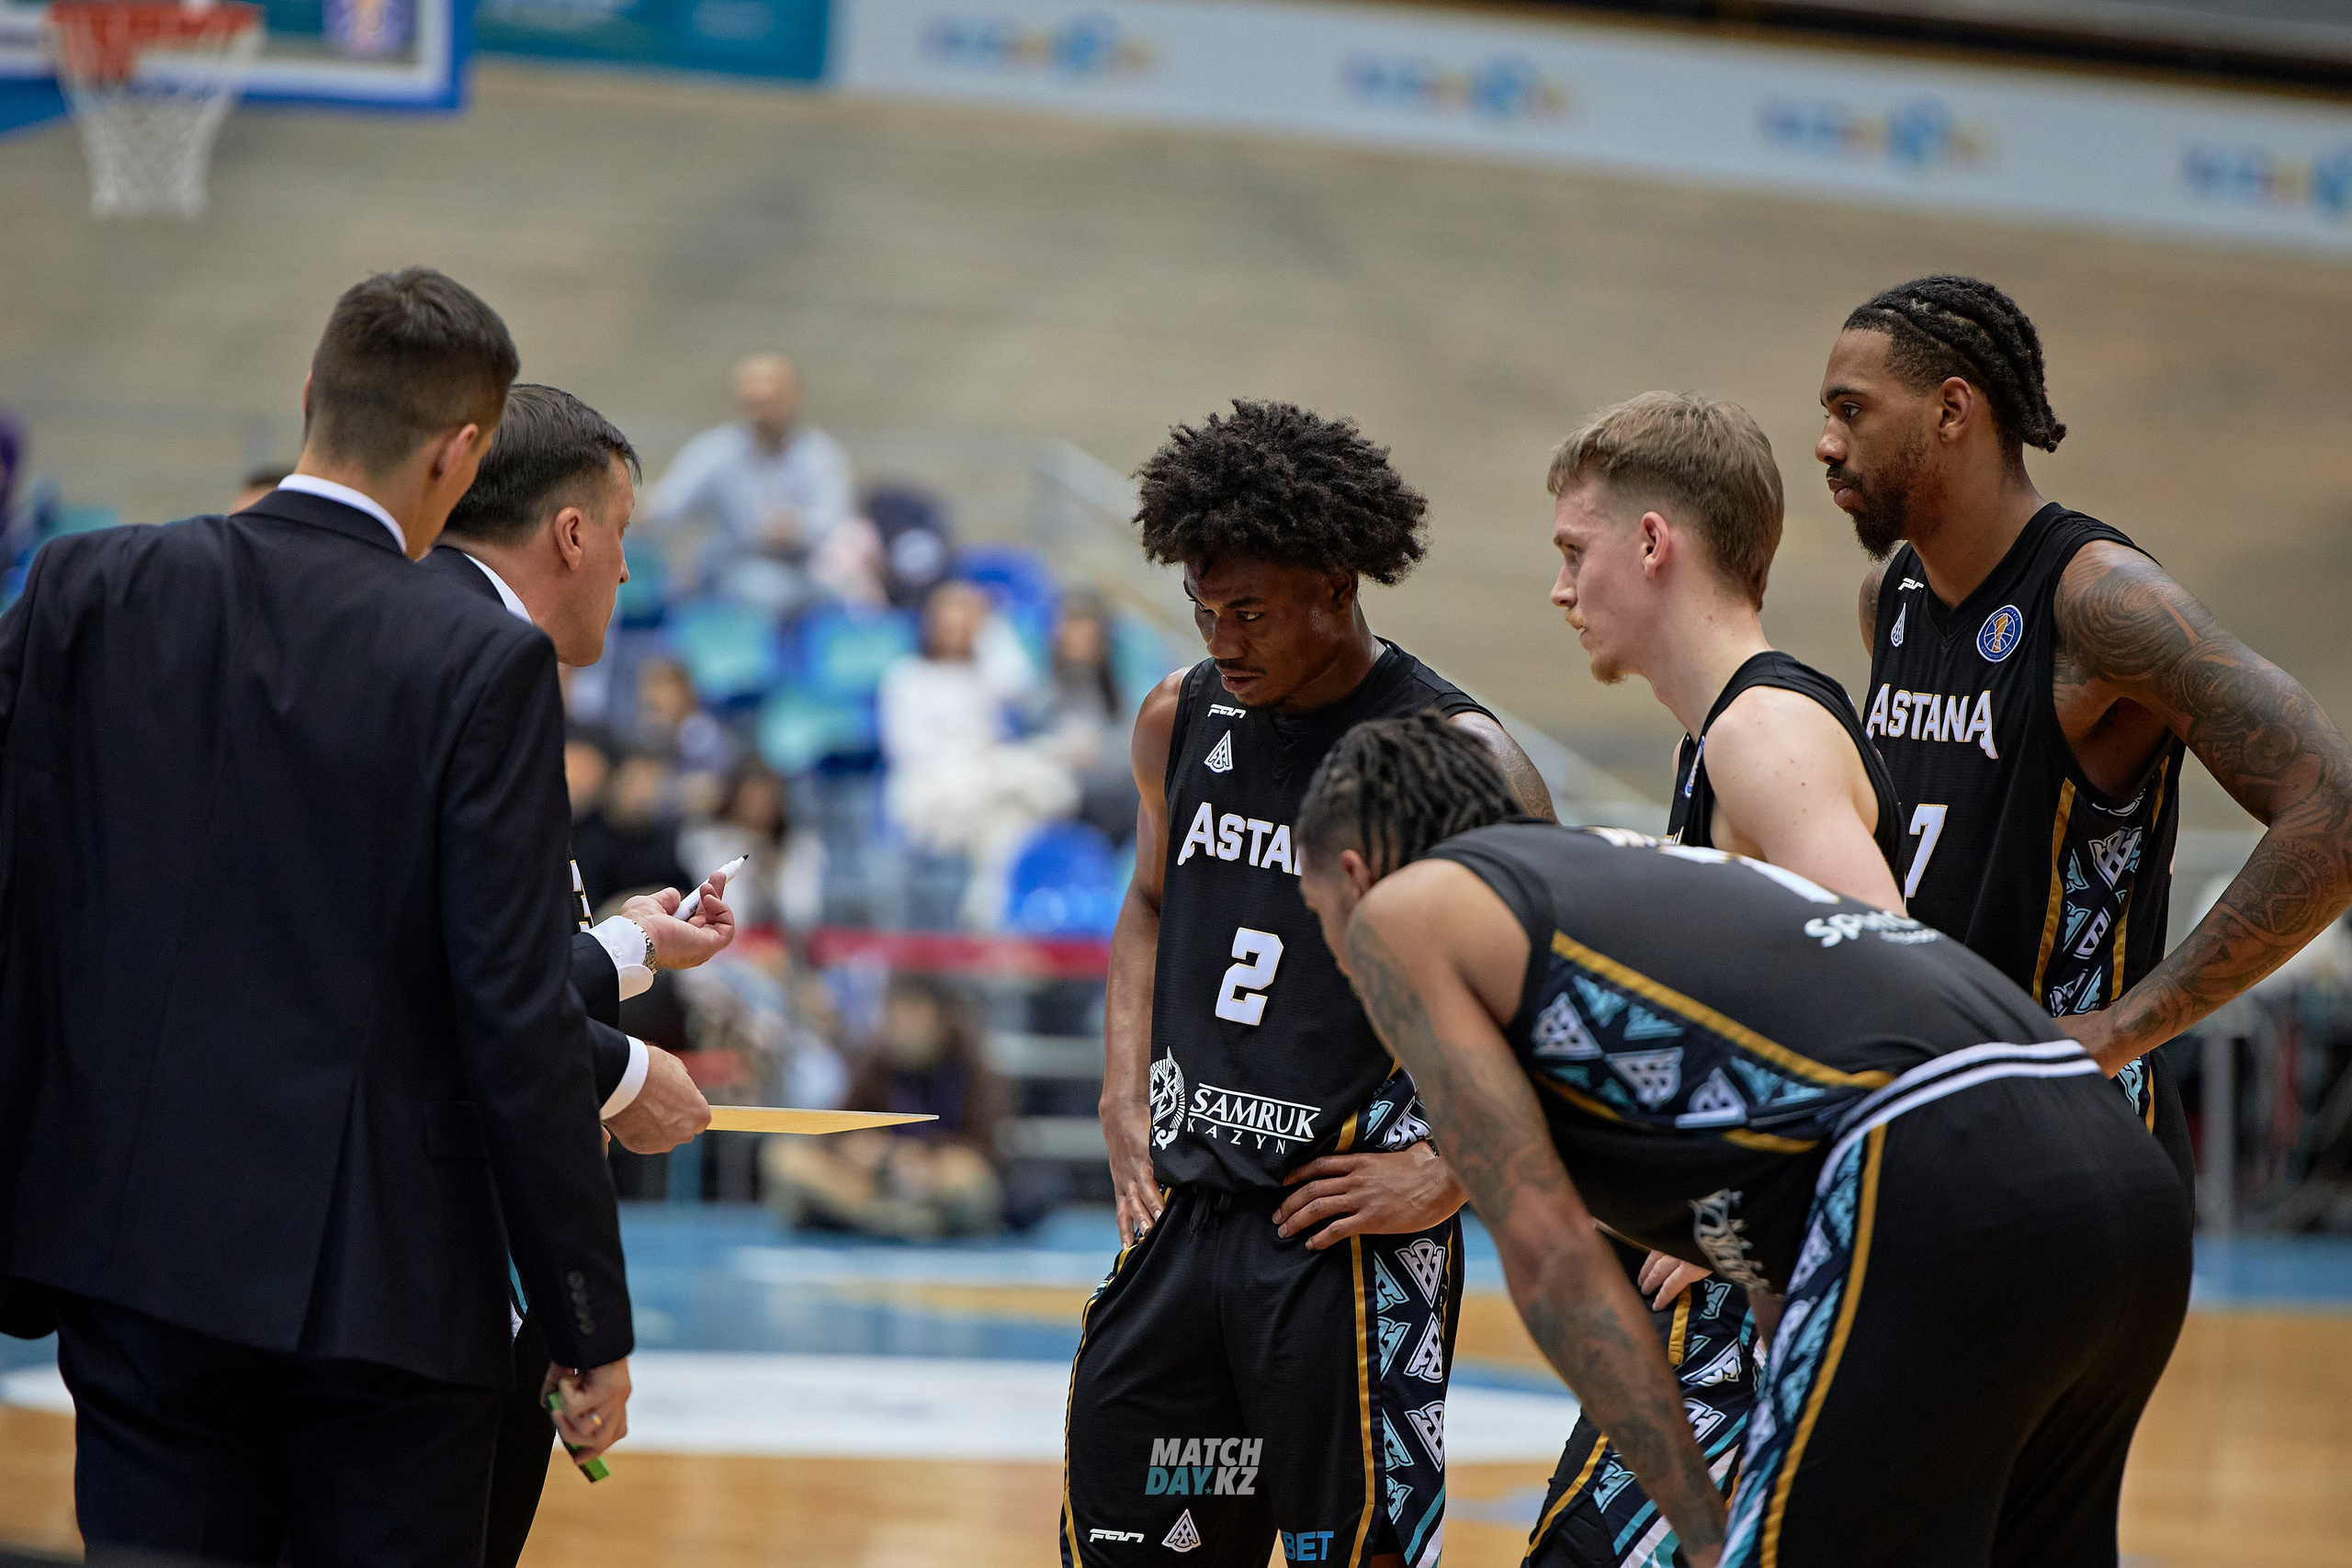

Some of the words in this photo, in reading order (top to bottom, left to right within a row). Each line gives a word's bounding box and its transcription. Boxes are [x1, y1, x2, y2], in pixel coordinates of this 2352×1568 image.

[1866, 683, 1998, 760] ASTANA
[1177, 801, 1302, 876] ASTA
[1216, 927, 1283, 1026] 2
[1190, 1089, 1320, 1138] SAMRUK
